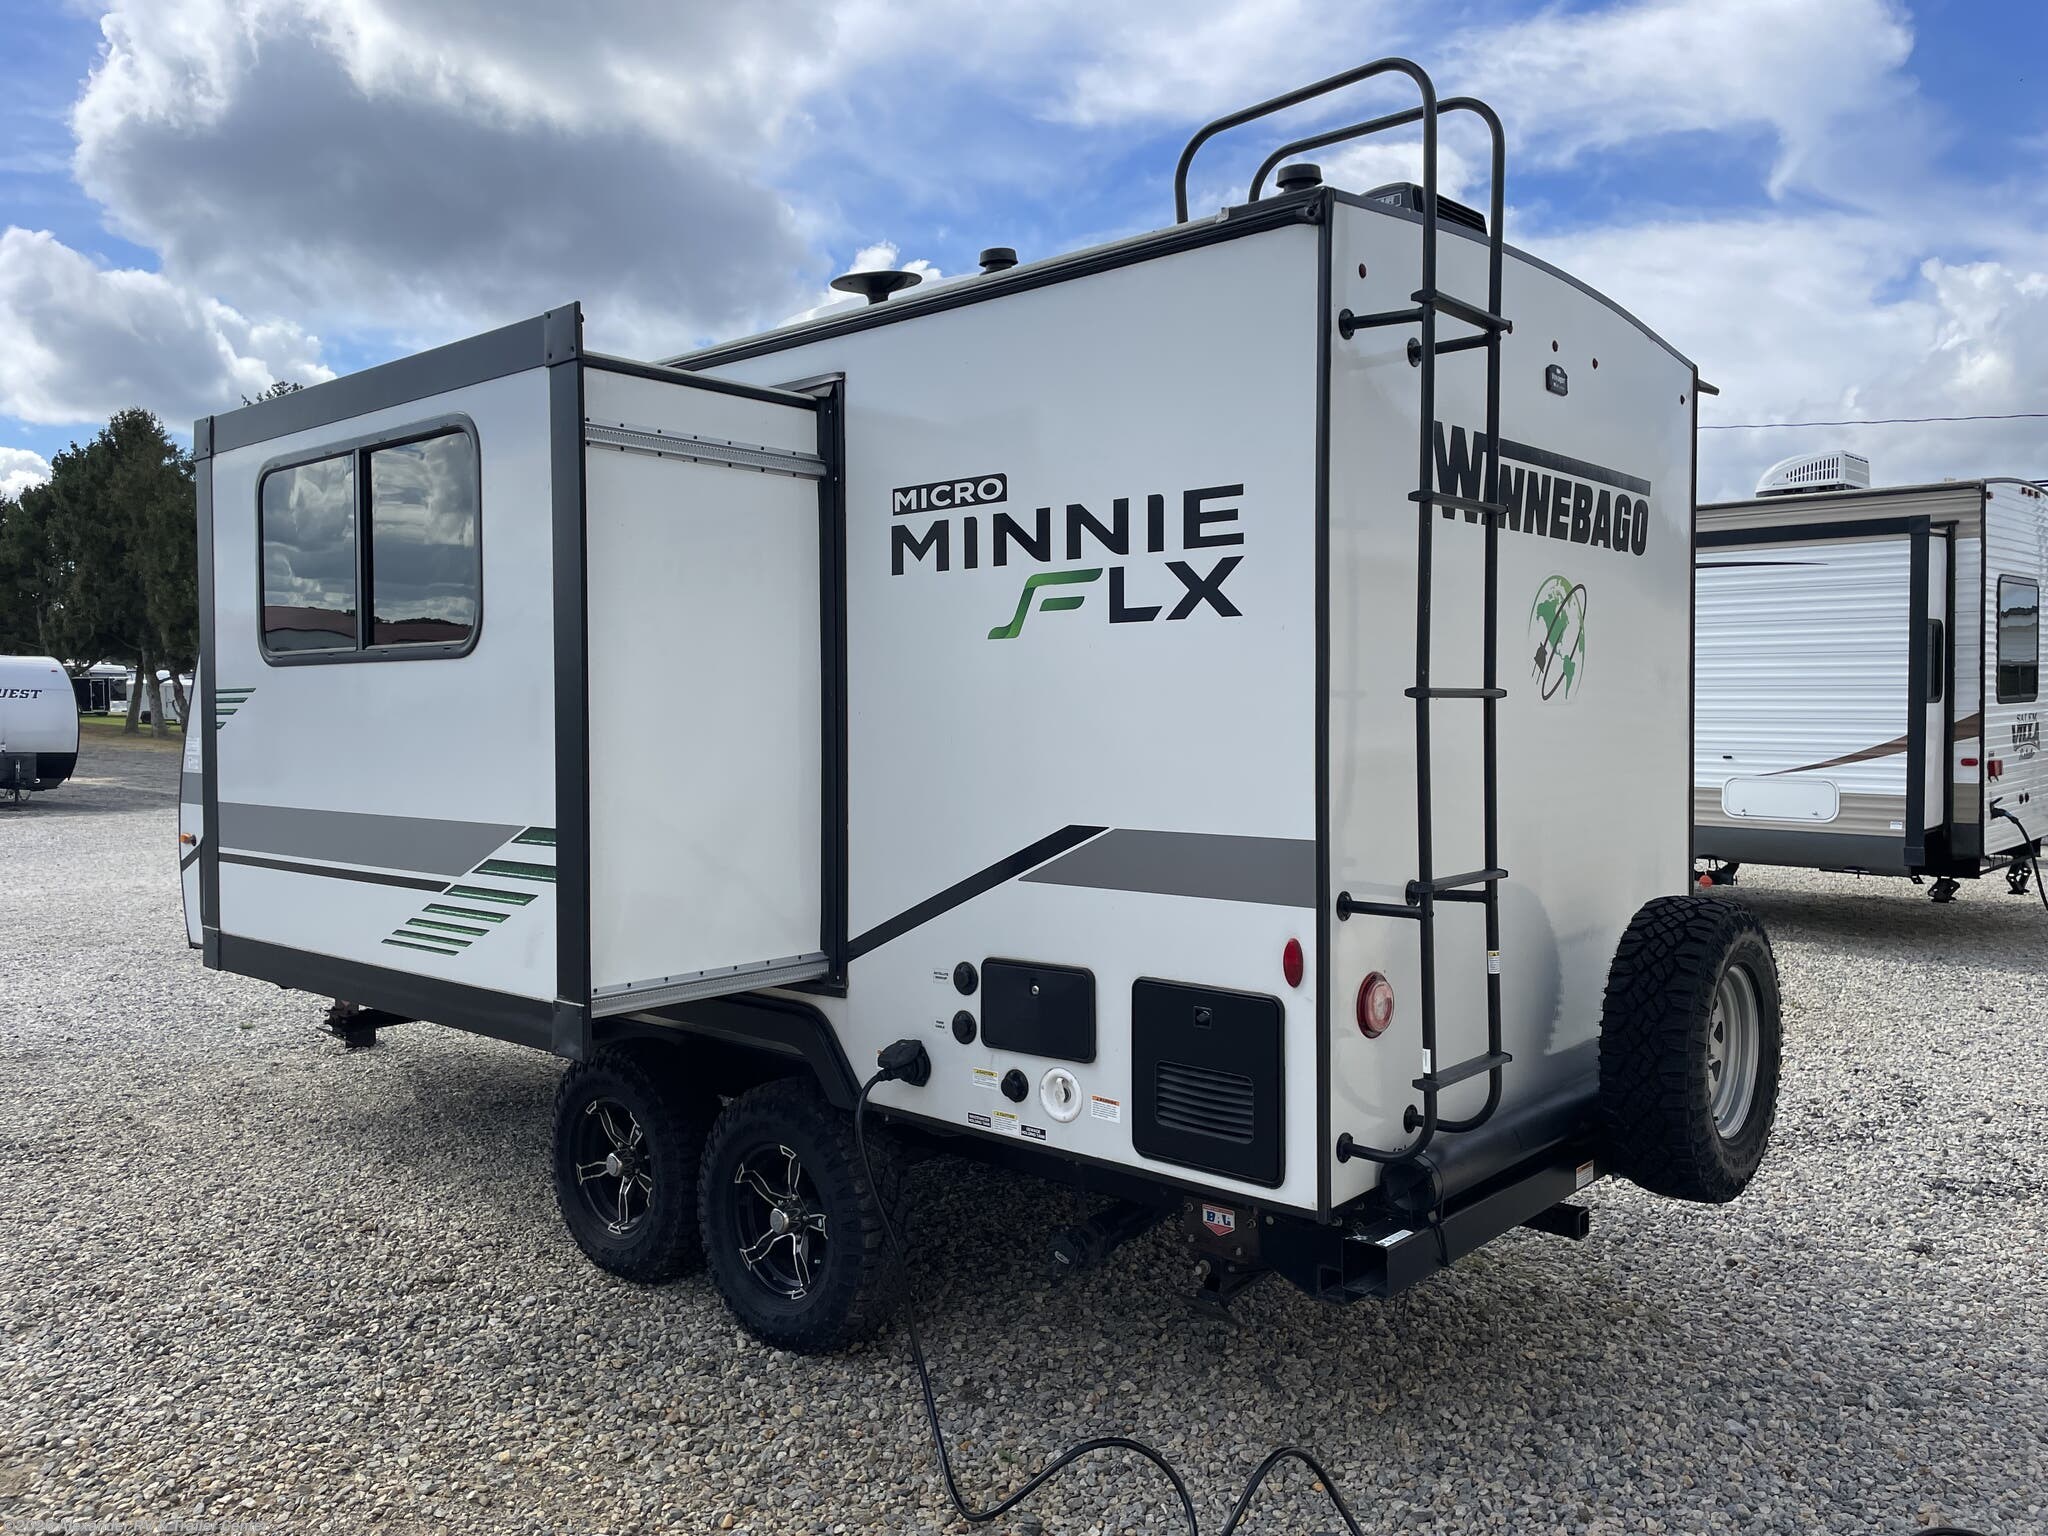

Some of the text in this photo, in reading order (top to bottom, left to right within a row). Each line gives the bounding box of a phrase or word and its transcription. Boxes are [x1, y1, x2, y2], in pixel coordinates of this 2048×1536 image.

[891, 483, 1245, 576] MINNIE
[893, 476, 1004, 513] MICRO
[1433, 420, 1649, 557] WNNEBAGO
[987, 555, 1244, 640] FLX
